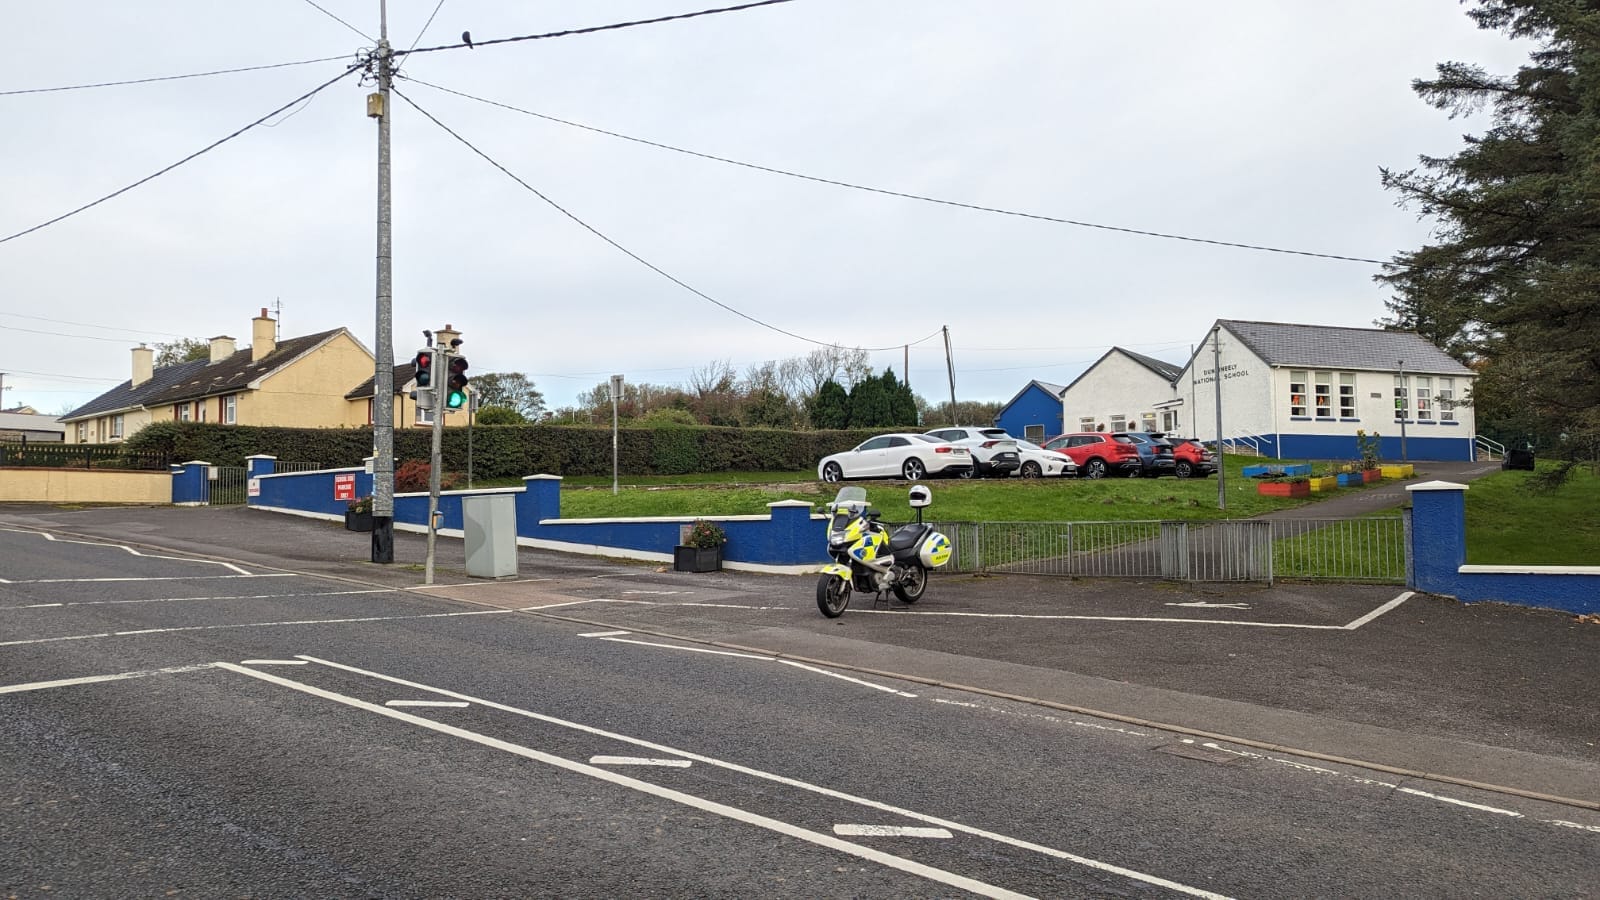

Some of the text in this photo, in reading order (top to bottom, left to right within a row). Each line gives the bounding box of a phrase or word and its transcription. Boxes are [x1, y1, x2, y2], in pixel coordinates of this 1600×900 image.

[1203, 364, 1237, 376] DUNNEELY
[1193, 370, 1249, 385] NATION SCHOOL
